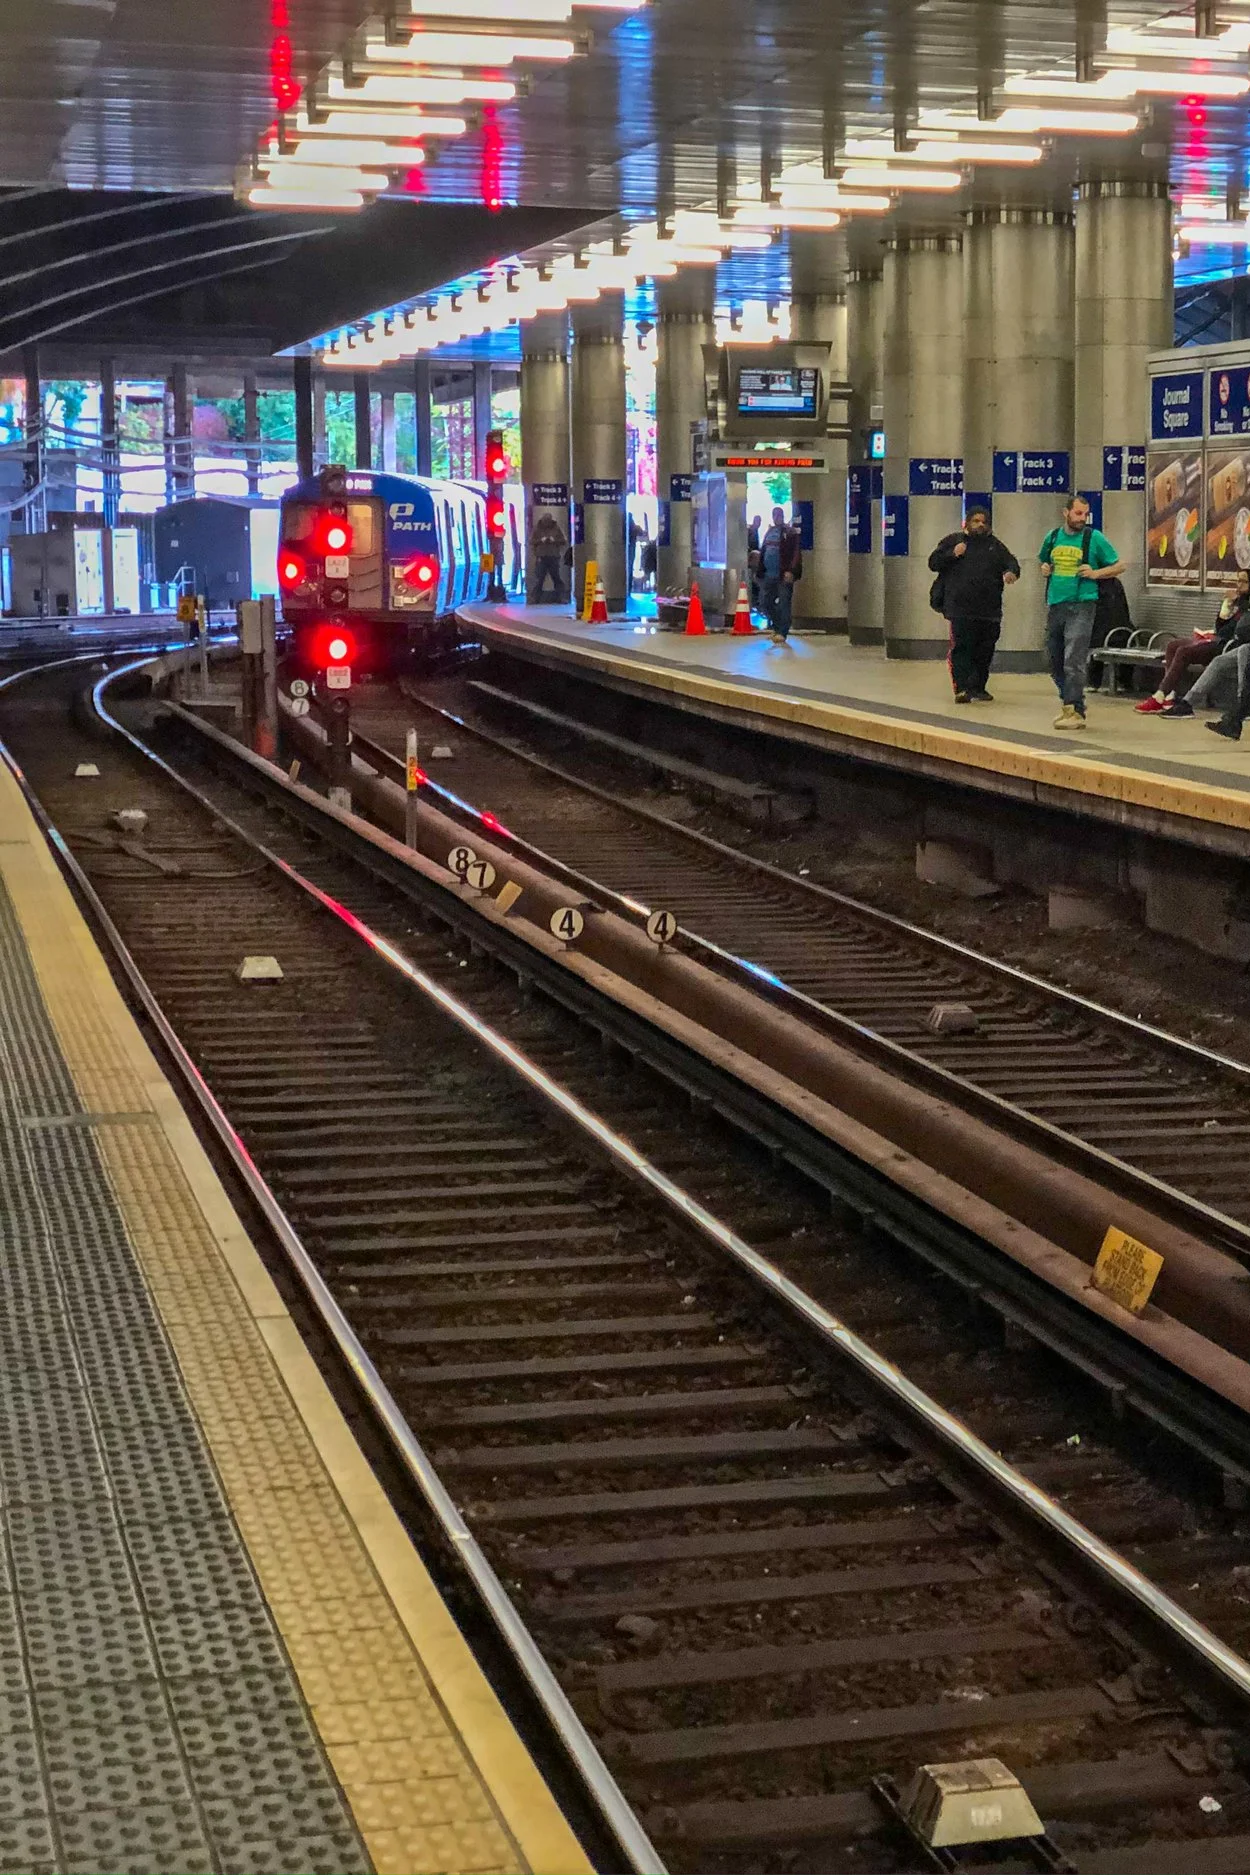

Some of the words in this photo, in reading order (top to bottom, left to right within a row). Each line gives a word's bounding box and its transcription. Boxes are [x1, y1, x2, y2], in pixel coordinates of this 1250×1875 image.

[1162, 386, 1190, 406] Journal
[1163, 409, 1190, 432] Square
[1018, 458, 1045, 468] Track
[1047, 458, 1053, 468] 3
[1121, 454, 1145, 464] Trac
[931, 464, 958, 474] Track
[958, 465, 964, 473] 3
[931, 480, 957, 490] Track
[1017, 476, 1045, 486] Track
[1046, 476, 1053, 486] 4
[1121, 474, 1145, 485] Trac
[393, 522, 431, 531] PATH
[295, 681, 305, 695] 8
[297, 700, 304, 713] 7
[456, 849, 468, 873] 8
[473, 862, 487, 887] 7
[559, 910, 575, 937] 4
[654, 912, 669, 940] 4
